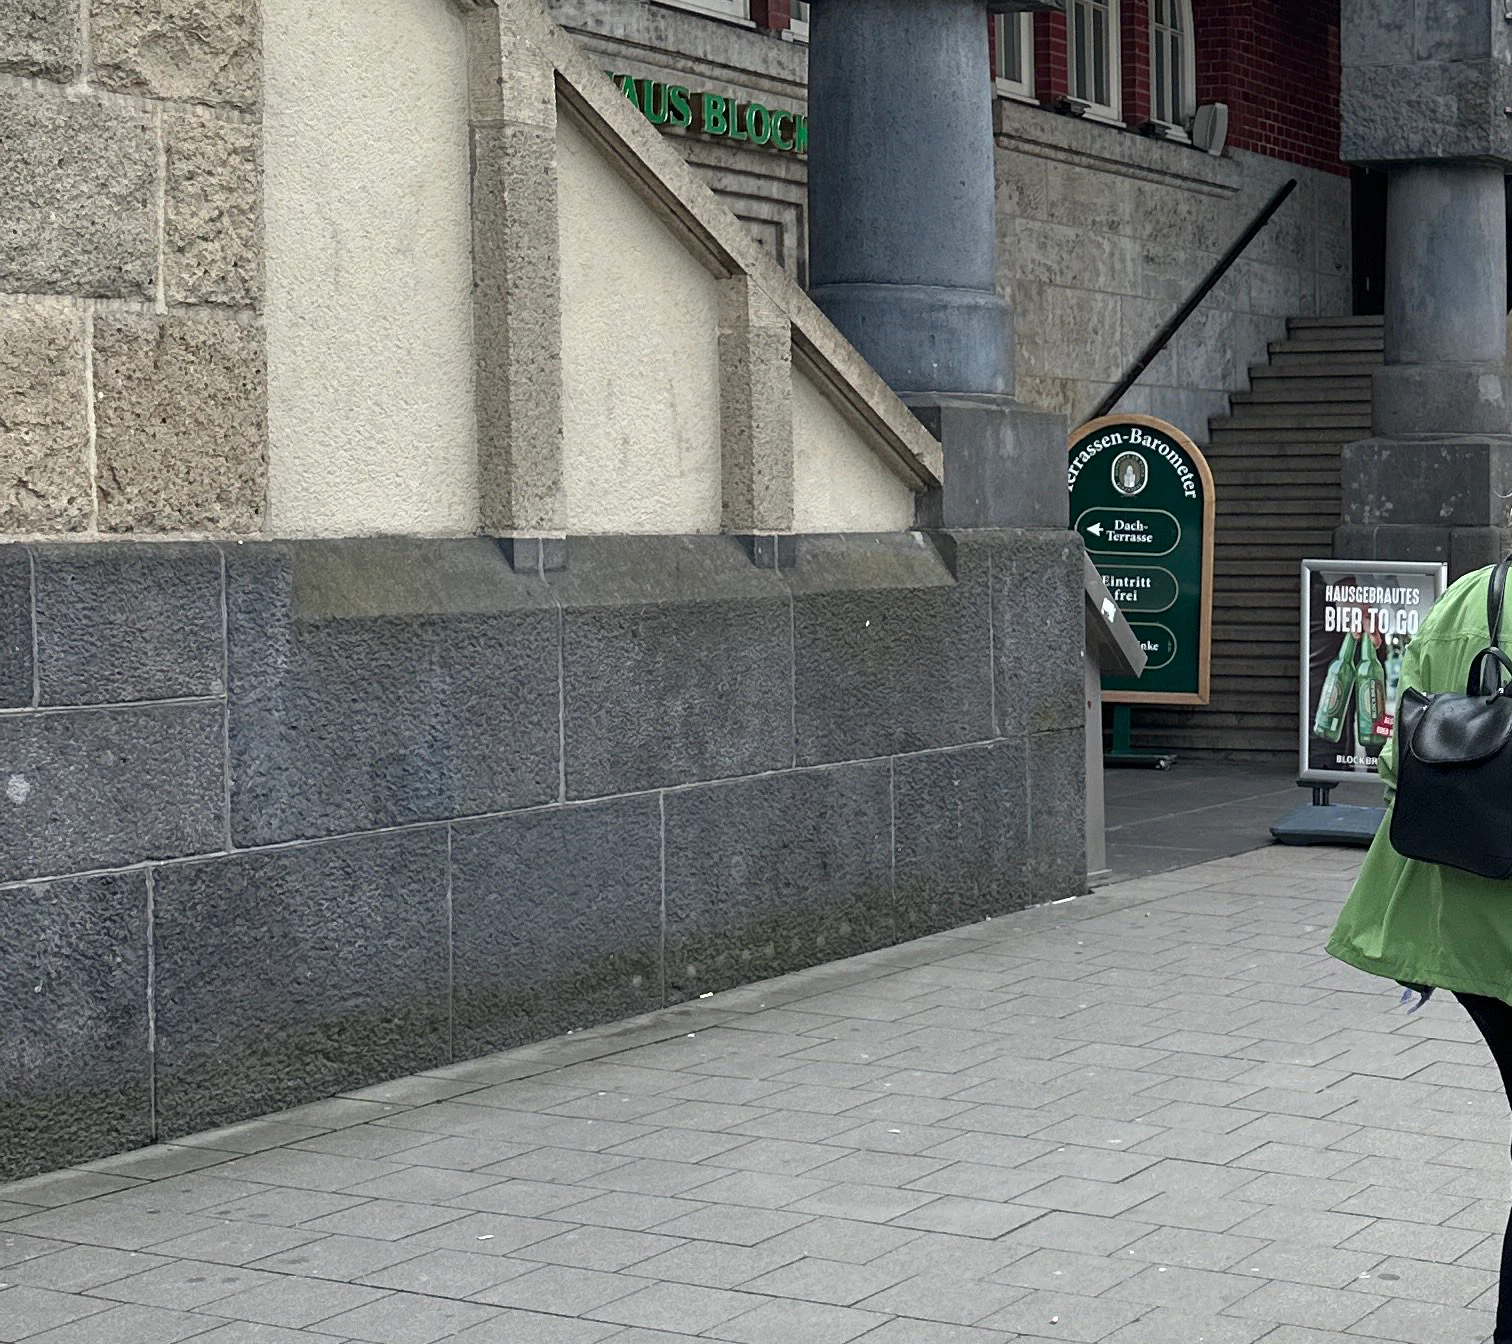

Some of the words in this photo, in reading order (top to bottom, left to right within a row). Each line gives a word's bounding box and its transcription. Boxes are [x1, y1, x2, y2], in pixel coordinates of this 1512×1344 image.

[604, 70, 693, 128] AUS
[1114, 519, 1149, 531] Dach-
[1106, 530, 1153, 543] Terrasse
[1101, 575, 1151, 588] Eintritt
[1114, 589, 1138, 602] frei
[1325, 585, 1420, 605] HAUSGEBRAUTES
[1325, 606, 1363, 633] BIER
[1368, 607, 1390, 635] TO
[1396, 609, 1420, 636] GO
